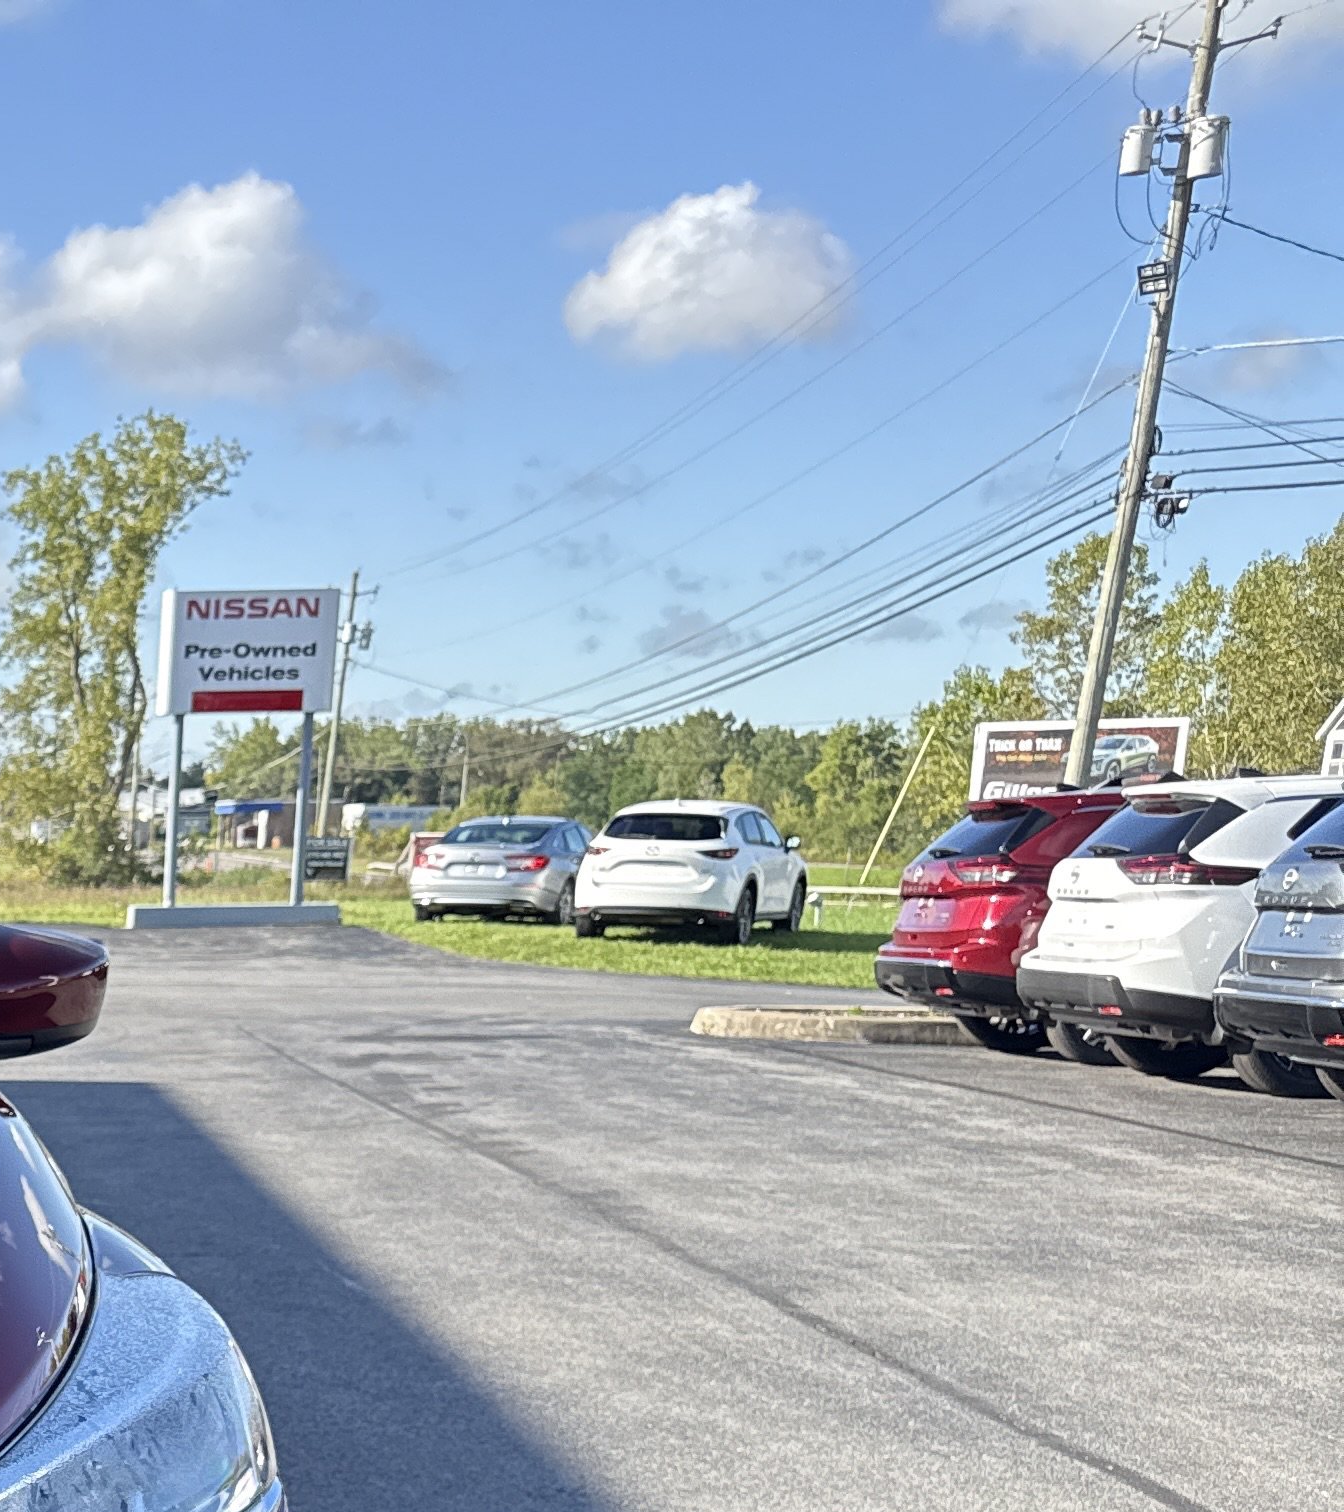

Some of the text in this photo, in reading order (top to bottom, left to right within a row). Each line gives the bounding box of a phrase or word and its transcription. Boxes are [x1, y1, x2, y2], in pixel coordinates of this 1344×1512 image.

[187, 597, 320, 620] NISSAN
[184, 641, 317, 659] Pre-Owned
[198, 665, 300, 681] Vehicles
